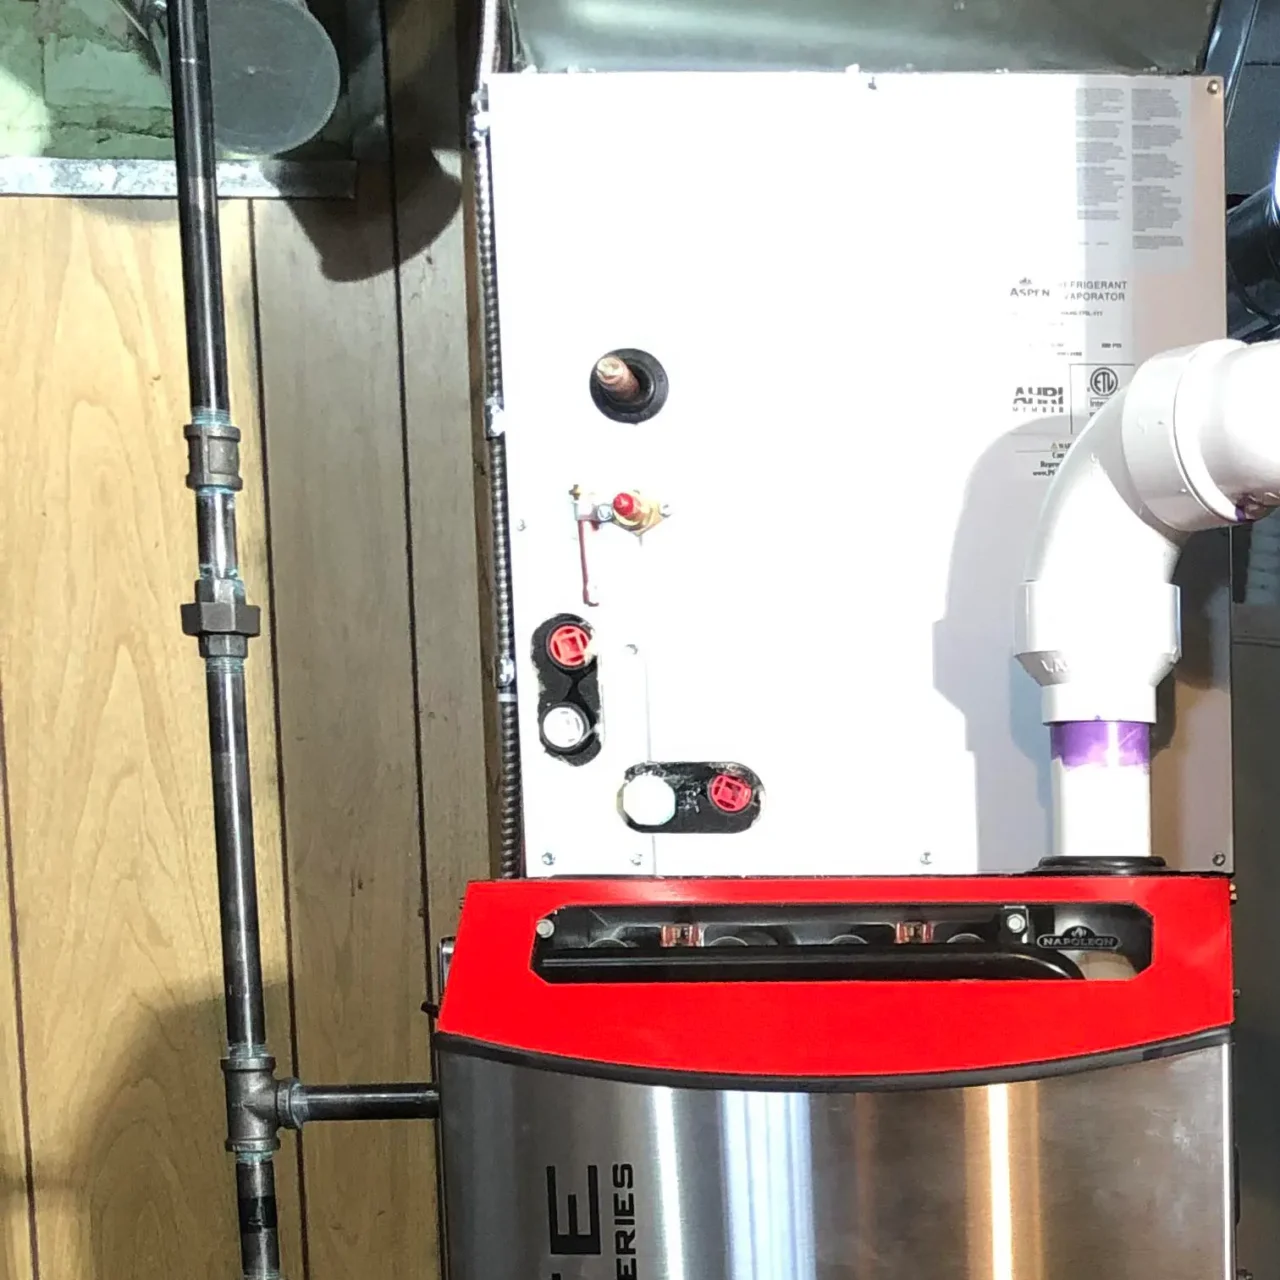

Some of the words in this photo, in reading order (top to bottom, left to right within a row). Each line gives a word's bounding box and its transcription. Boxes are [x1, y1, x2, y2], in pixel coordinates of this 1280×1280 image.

[1059, 280, 1127, 290] FRIGERANT
[1062, 292, 1125, 301] APORATOR
[1043, 937, 1114, 946] NAPOLEON
